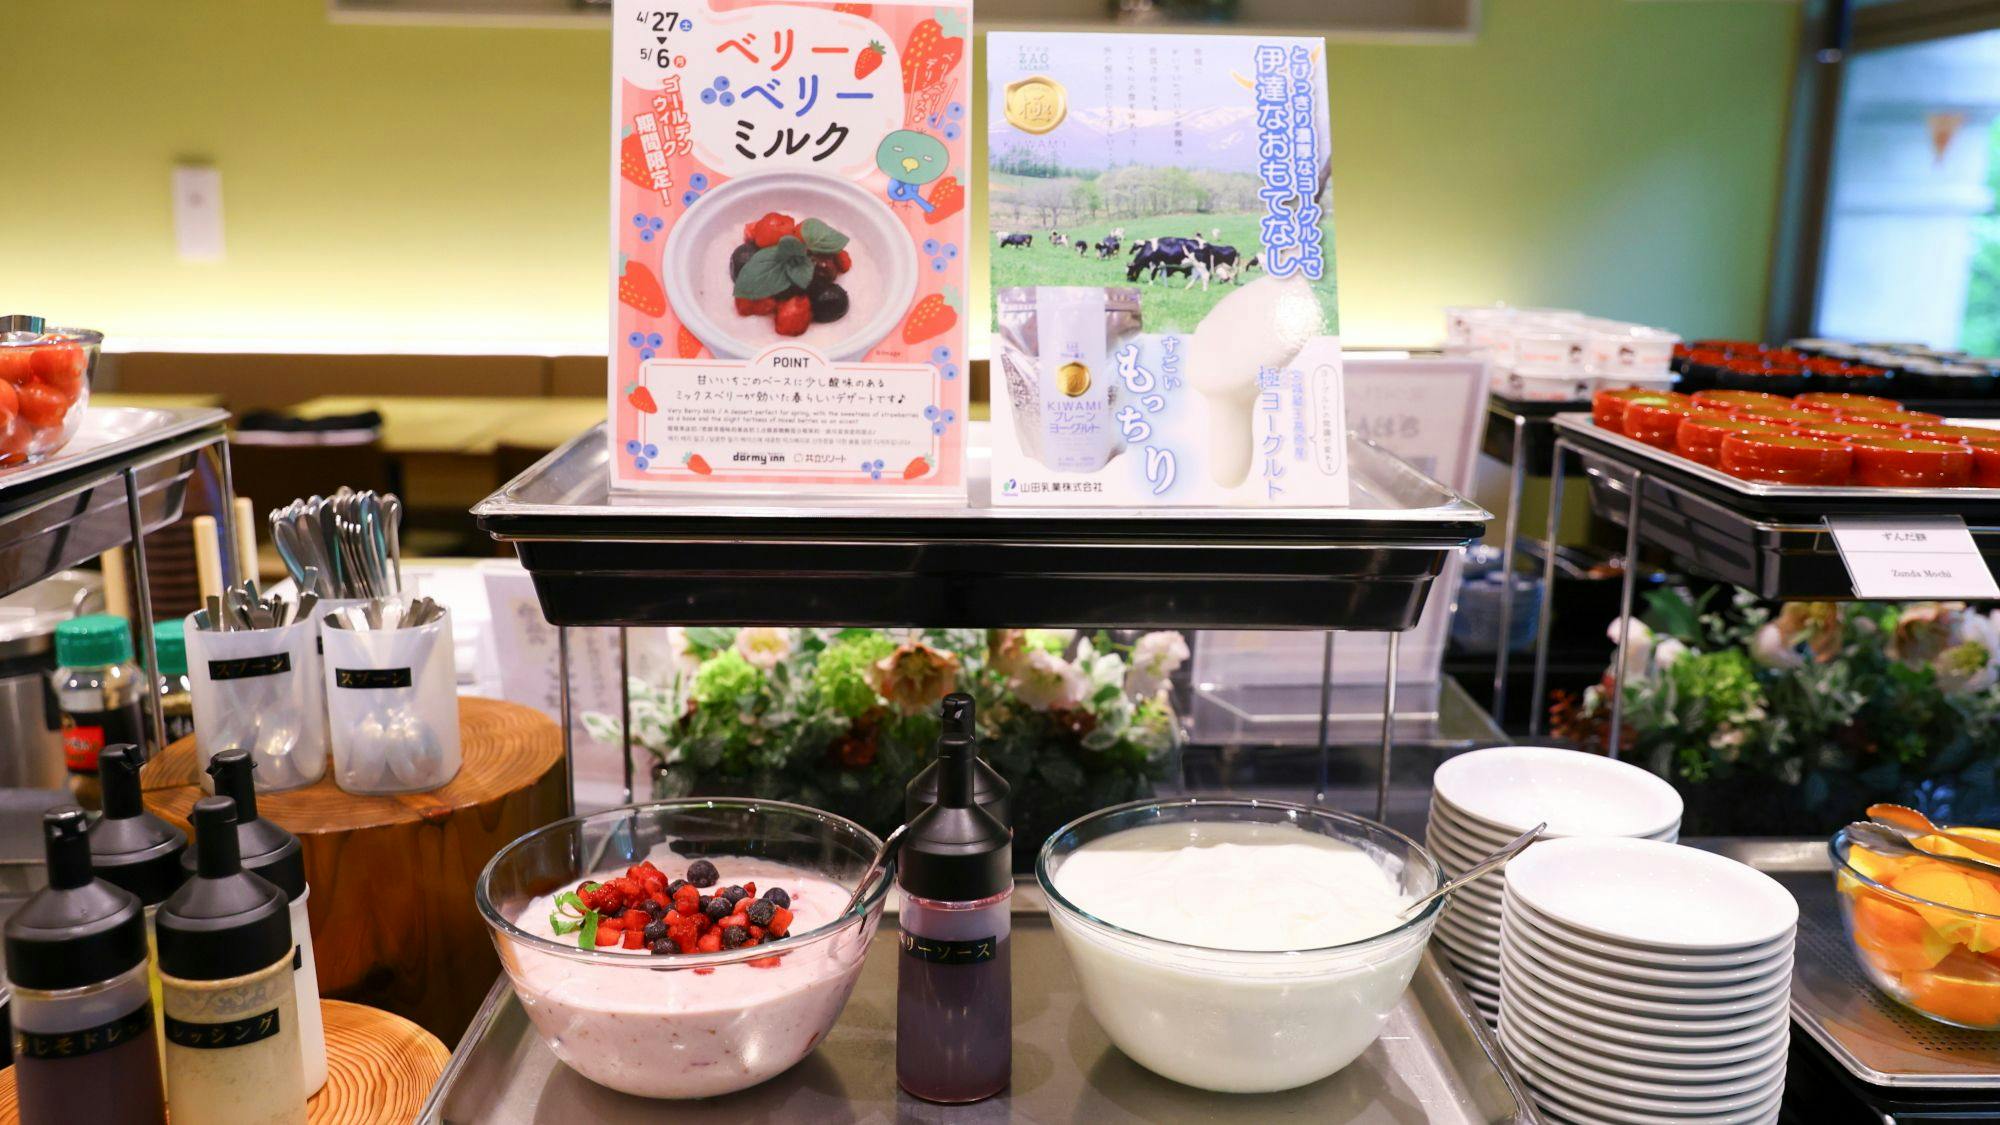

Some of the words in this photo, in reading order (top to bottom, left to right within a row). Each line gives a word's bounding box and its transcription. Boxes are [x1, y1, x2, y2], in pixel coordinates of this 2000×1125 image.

[716, 29, 849, 71] ベリー
[663, 74, 693, 156] ゴールデン
[741, 75, 874, 117] ベリー
[652, 95, 677, 157] ウィーク
[735, 120, 849, 162] ミルク
[1255, 45, 1297, 276] 伊達なおもてなし
[773, 357, 810, 368] POINT
[1047, 401, 1102, 411] KIWAMI
[1054, 412, 1096, 422] プレーン
[1115, 343, 1177, 496] もっちり
[1050, 423, 1101, 433] ヨーグルト
[733, 452, 767, 465] dormy
[1020, 482, 1103, 493] 山田乳業株式会社
